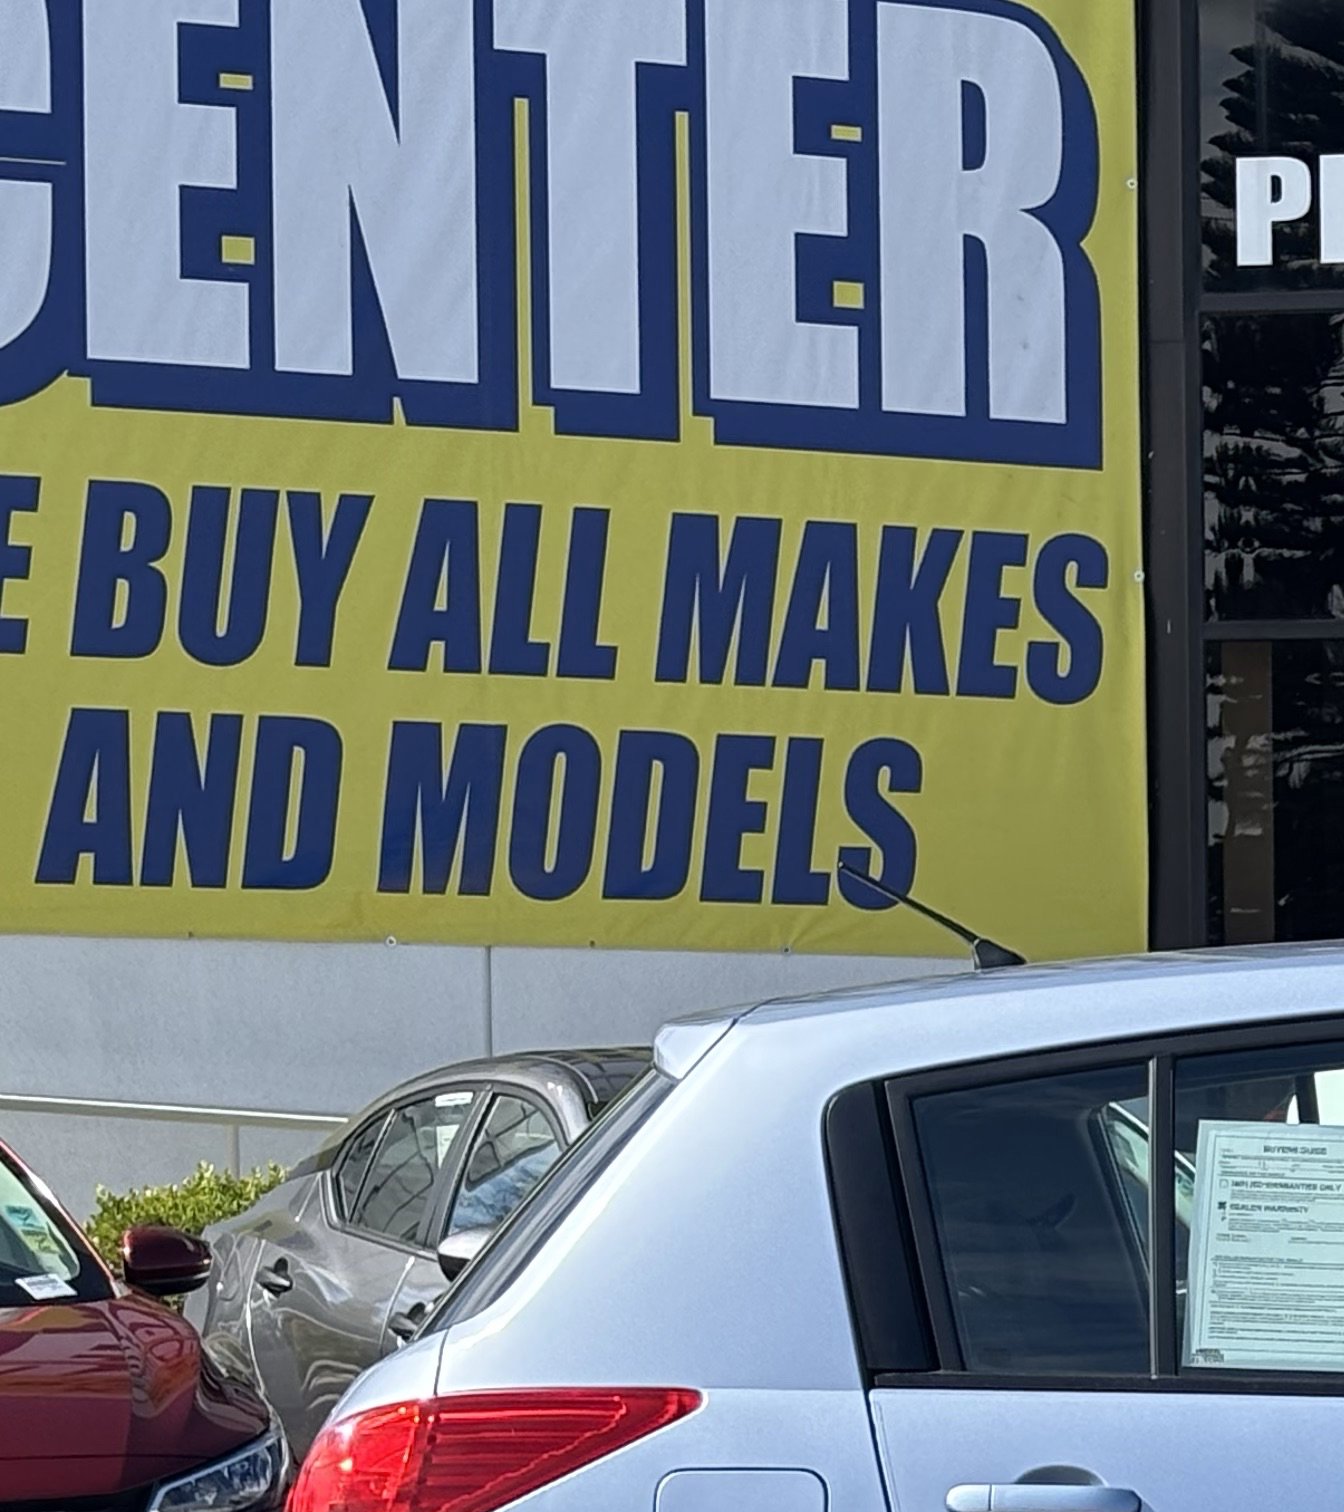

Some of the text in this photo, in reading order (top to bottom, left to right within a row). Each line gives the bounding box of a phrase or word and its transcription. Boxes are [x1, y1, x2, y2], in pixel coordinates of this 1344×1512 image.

[71, 480, 374, 666] BUY
[389, 499, 616, 679] ALL
[655, 513, 1108, 705] MAKES
[36, 708, 922, 910] AND MODELS
